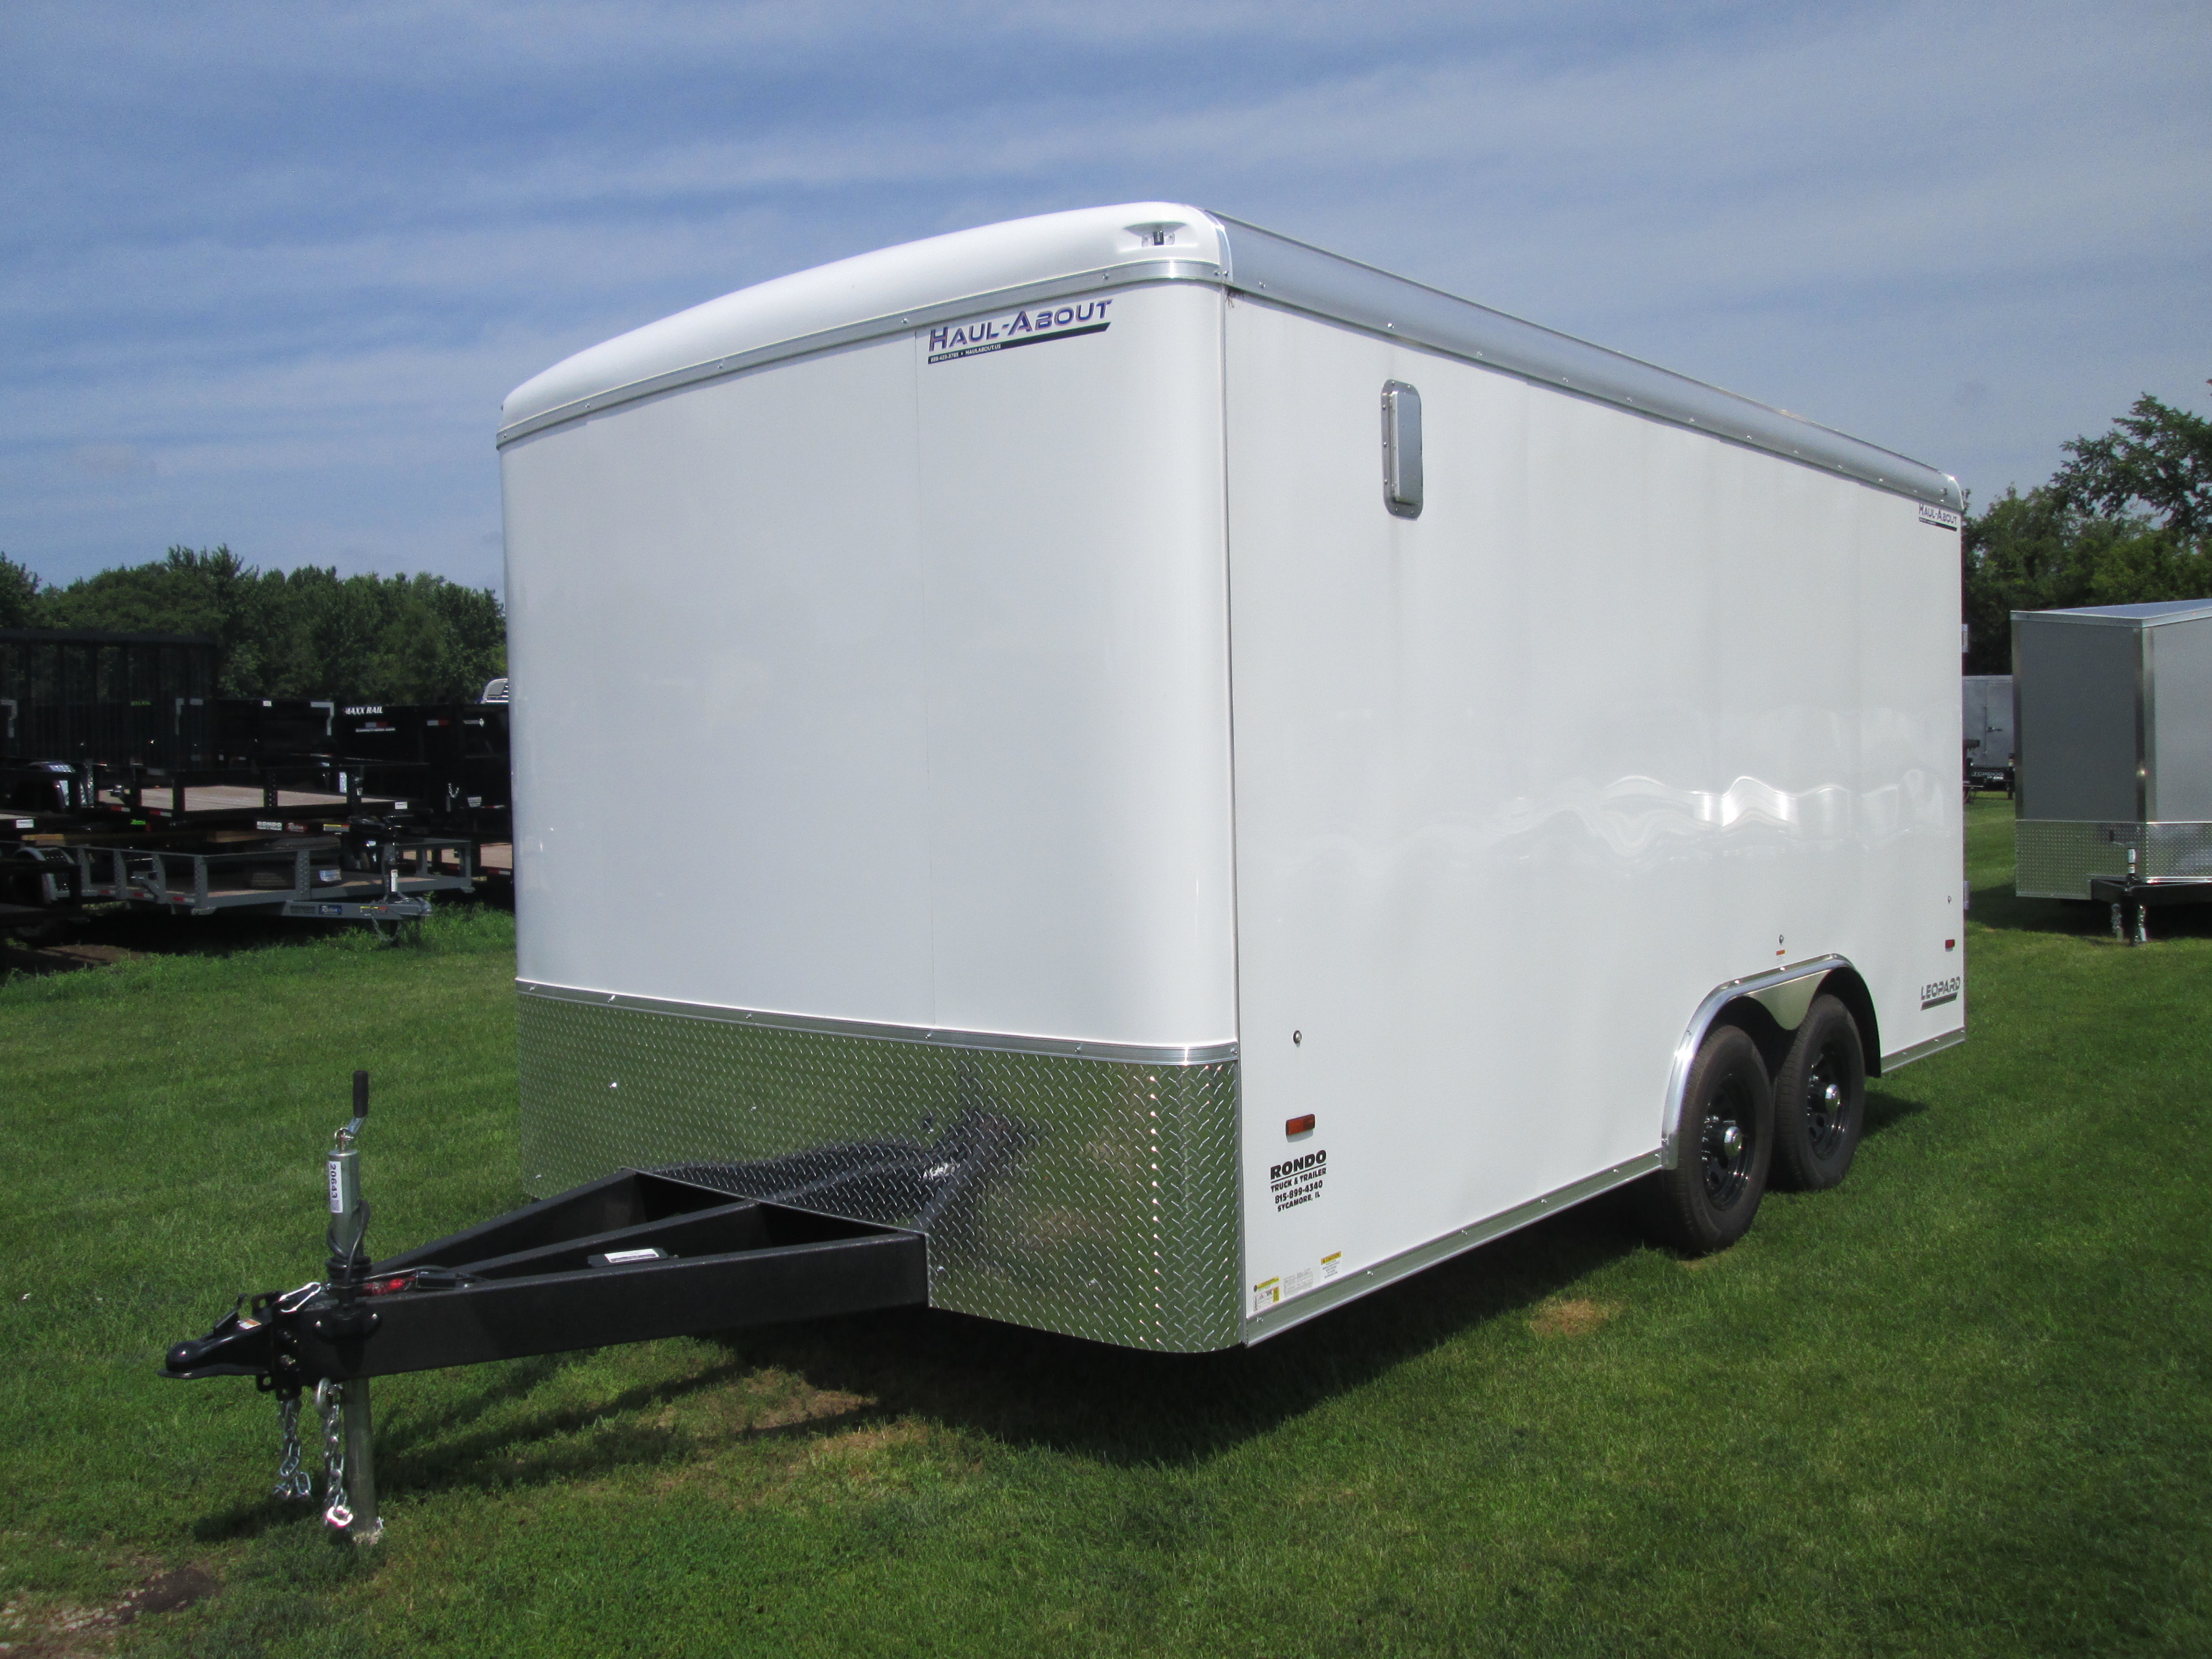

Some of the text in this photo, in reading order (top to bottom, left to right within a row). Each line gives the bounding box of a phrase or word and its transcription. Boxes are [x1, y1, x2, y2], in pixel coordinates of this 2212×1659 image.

[929, 299, 1113, 352] HAUL-ABOUT
[1919, 504, 1958, 525] HAUL-ABOUT
[366, 706, 383, 714] RAIL
[1921, 977, 1961, 1000] LEOPARD
[1271, 1150, 1326, 1180] RONDO
[1271, 1168, 1326, 1193] TRUCK & TRAILER
[1275, 1180, 1323, 1204] 815-899-4340
[1277, 1194, 1313, 1212] SYCAMORE,
